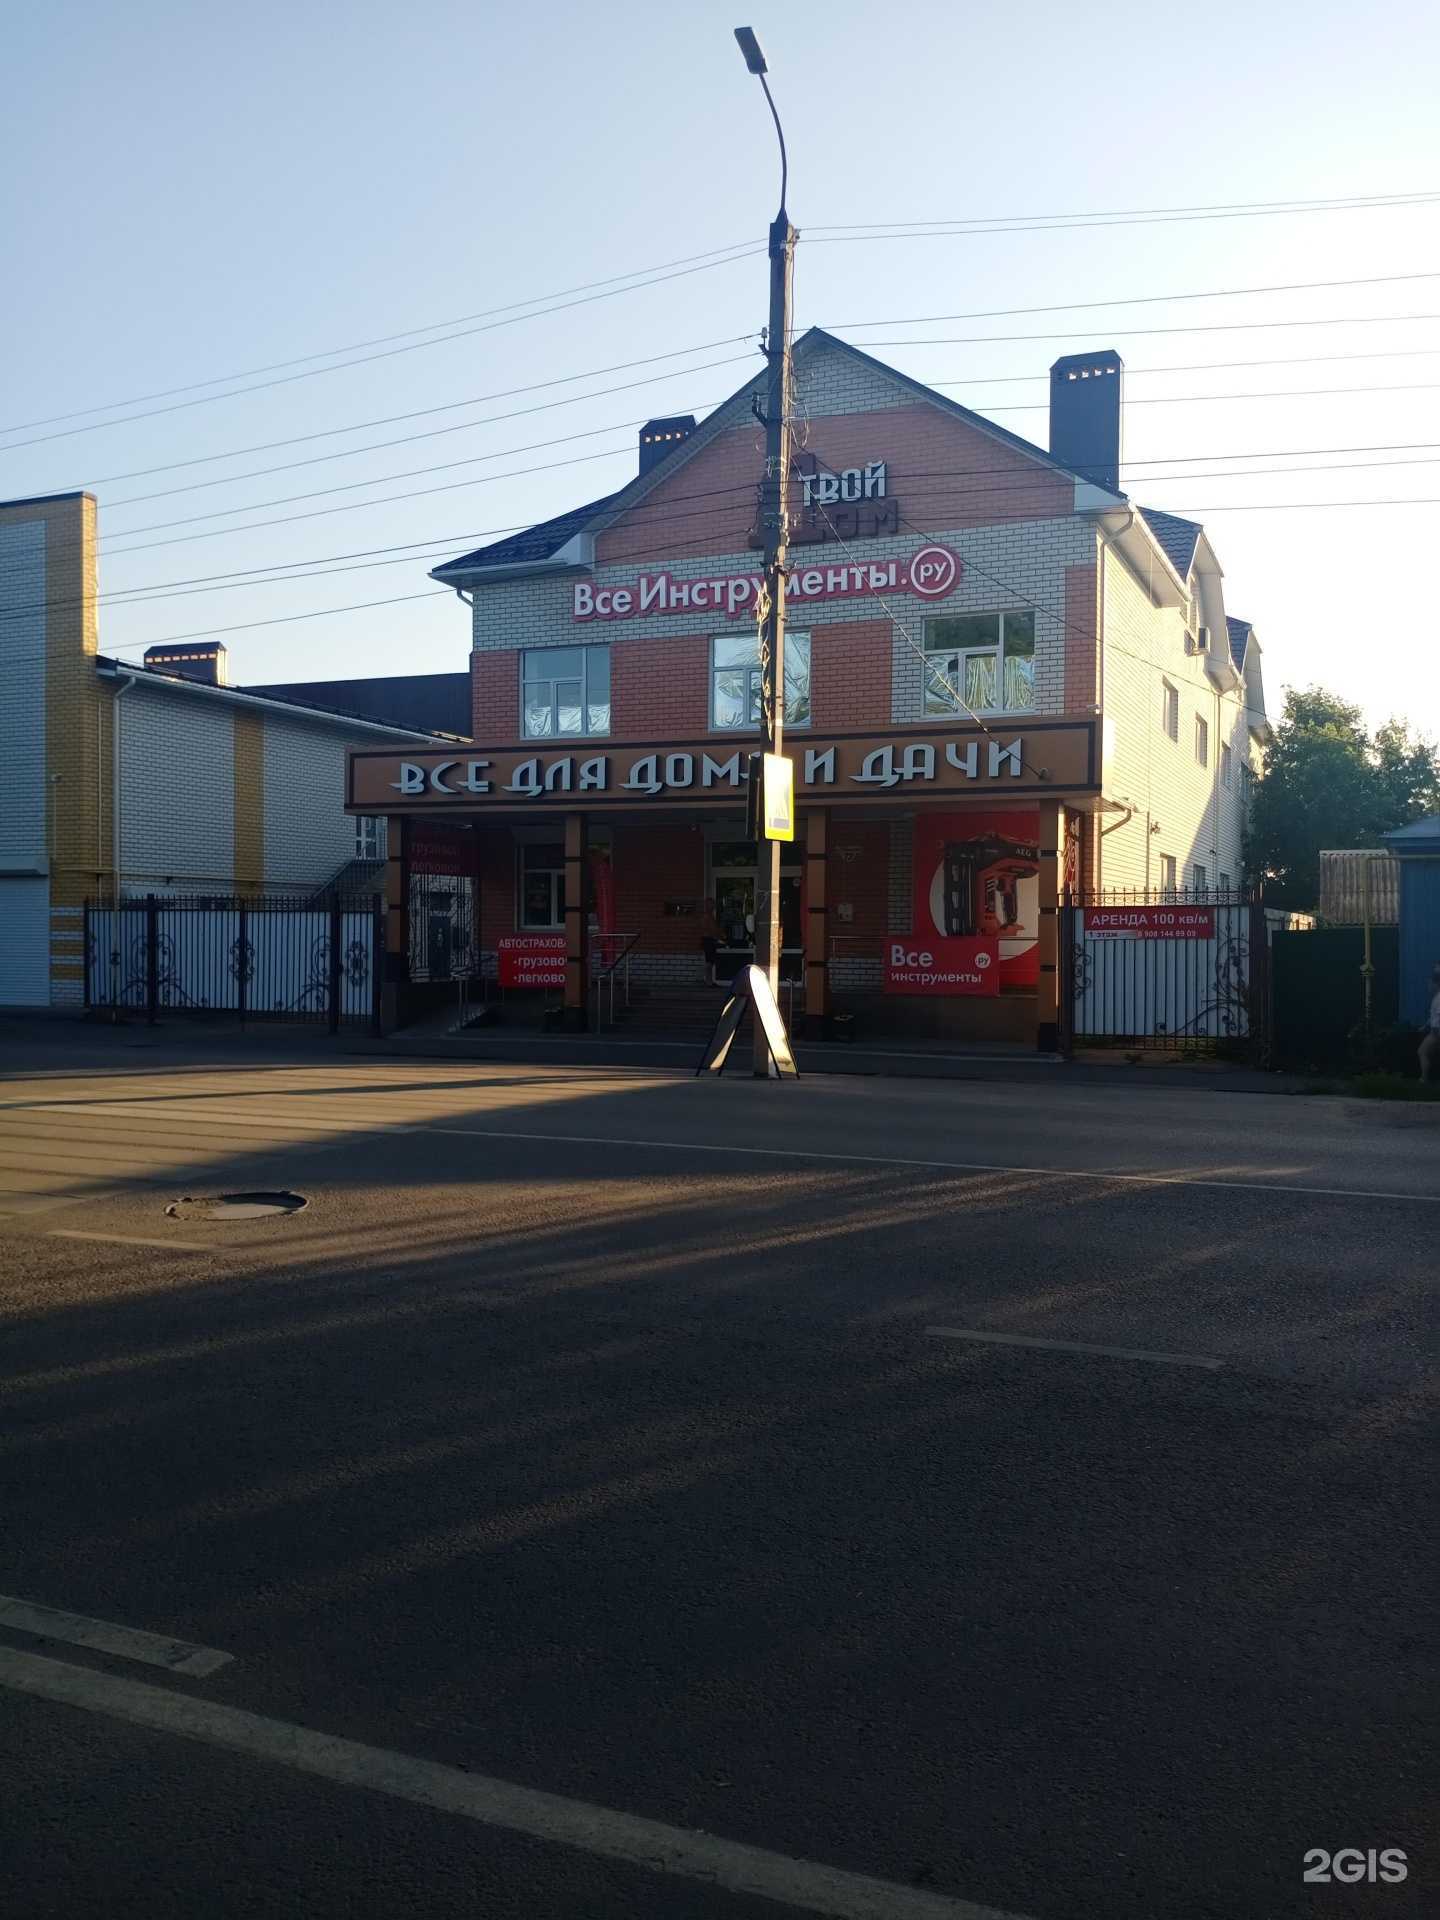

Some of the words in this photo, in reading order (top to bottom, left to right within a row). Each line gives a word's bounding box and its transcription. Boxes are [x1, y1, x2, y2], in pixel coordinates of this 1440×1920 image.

[798, 460, 885, 506] ТВОЙ
[574, 583, 632, 617] Все
[388, 760, 493, 795] ВСЕ
[502, 756, 608, 797] ДЛЯ
[618, 752, 763, 795] ДОМ
[804, 745, 836, 785] И
[847, 738, 1022, 788] ДАЧИ
[1091, 914, 1148, 926] АРЕНДА
[1152, 914, 1175, 925] 100
[1178, 913, 1208, 925] кв/м
[518, 957, 567, 968] грузово
[890, 944, 934, 967] Все
[890, 972, 982, 985] инструменты
